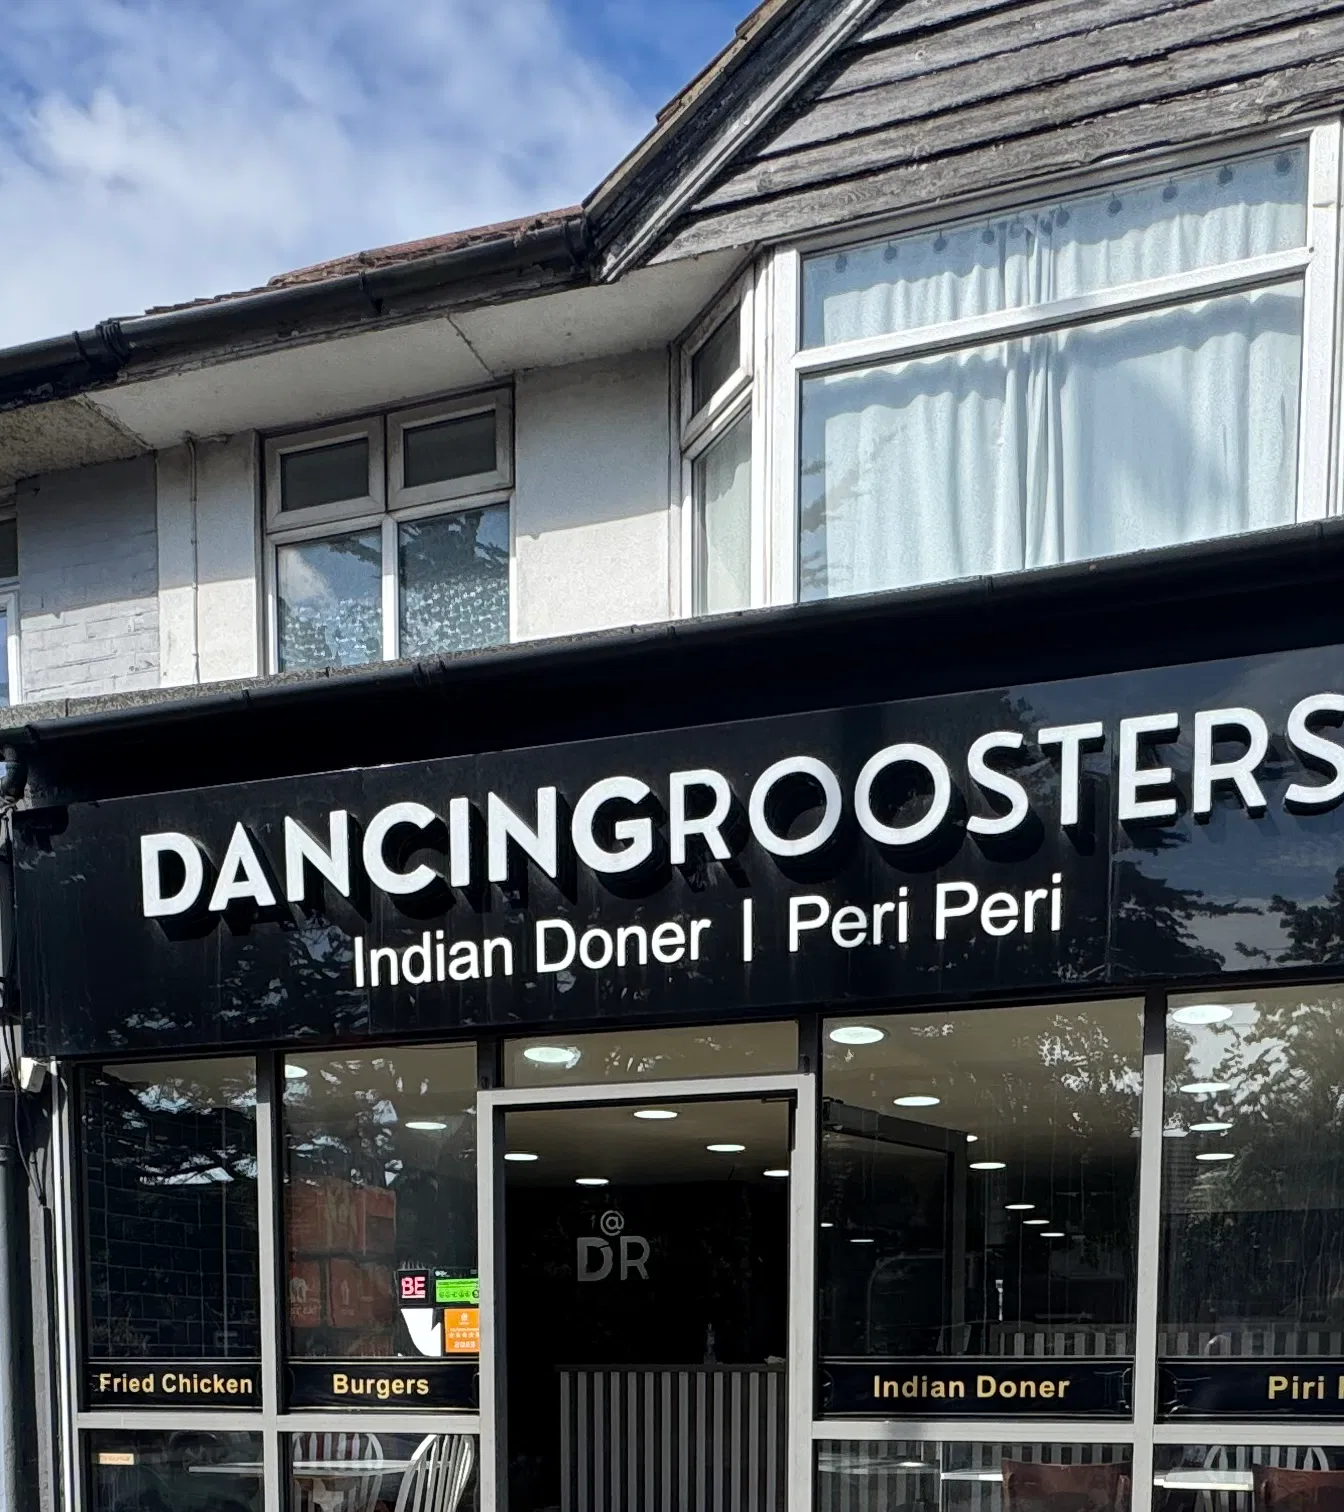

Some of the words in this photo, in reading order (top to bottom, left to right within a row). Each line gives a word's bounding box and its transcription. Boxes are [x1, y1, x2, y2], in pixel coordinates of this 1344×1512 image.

[353, 928, 514, 989] Indian
[535, 918, 712, 974] Doner
[789, 887, 909, 953] Peri
[935, 873, 1063, 941] Peri
[577, 1235, 651, 1281] DR
[401, 1276, 426, 1296] BE
[99, 1373, 154, 1393] Fried
[161, 1373, 253, 1394] Chicken
[333, 1373, 430, 1399] Burgers
[873, 1375, 965, 1399] Indian
[976, 1375, 1070, 1398] Doner
[1268, 1375, 1326, 1399] Piri
